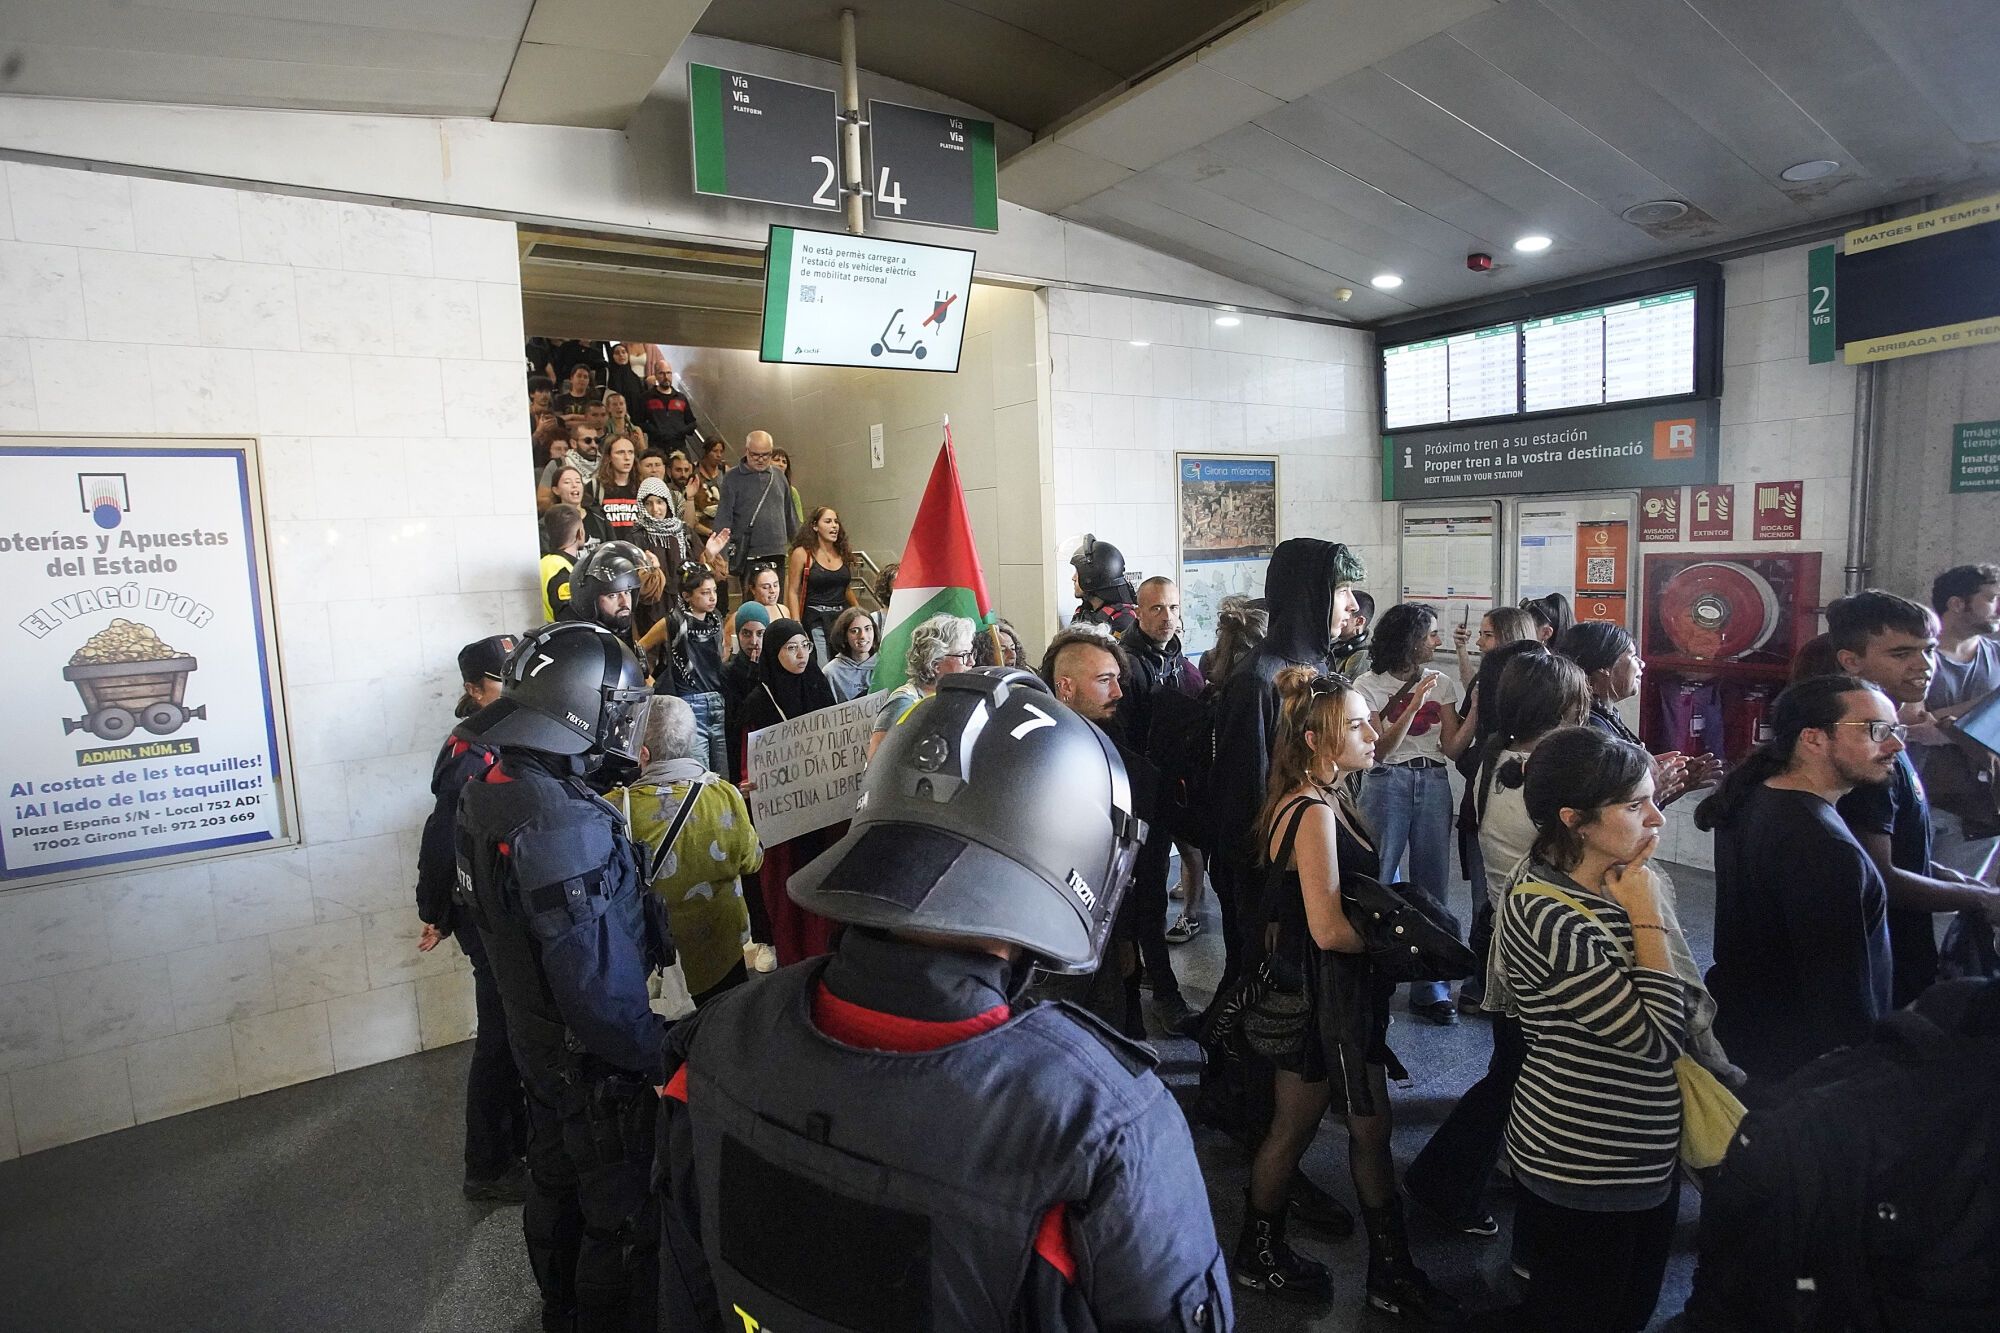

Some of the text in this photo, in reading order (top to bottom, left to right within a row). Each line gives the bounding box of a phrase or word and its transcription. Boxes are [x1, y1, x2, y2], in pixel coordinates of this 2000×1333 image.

[732, 76, 748, 88] Vía
[733, 90, 749, 104] Via
[733, 105, 762, 115] PLATFORM
[940, 143, 964, 151] PLATFORM
[950, 131, 963, 142] Via
[811, 156, 836, 206] 2
[878, 166, 907, 214] 4
[1853, 225, 1912, 246] IMATGES
[1917, 219, 1935, 230] EN
[1940, 206, 1990, 224] TEMPS
[803, 245, 813, 253] No
[816, 247, 833, 256] està
[836, 250, 865, 260] permès
[868, 253, 900, 264] carregar
[802, 256, 836, 268] l'estació
[852, 263, 883, 273] vehicles
[886, 266, 916, 277] elèctrics
[814, 270, 851, 280] mobilitat
[854, 275, 887, 284] personal
[1812, 286, 1830, 315] 2
[1812, 315, 1830, 326] Vía
[1867, 336, 1937, 354] ARRIBADA
[1942, 331, 1960, 342] DE
[1425, 430, 1588, 456] Próximo tren a su estación
[1670, 425, 1692, 448] R
[1962, 428, 2000, 438] Imáge
[1424, 441, 1643, 472] Proper tren a la vostra destinació
[1204, 466, 1228, 475] Girona
[1424, 470, 1523, 484] NEXT TRAIN TO YOUR STATION
[1961, 465, 1999, 474] temps
[0, 529, 229, 554] oterías y Apuestas
[47, 554, 177, 577] del Estado
[19, 582, 214, 639] EL VAGÓ D'OR
[530, 654, 554, 677] 7
[566, 712, 590, 730] T6X178
[1010, 703, 1057, 740] 7
[756, 730, 776, 750] PAZ
[782, 722, 808, 740] PARA
[82, 743, 192, 765] ADMIN. NÚM. 15
[754, 749, 778, 770] PARA
[781, 746, 793, 762] LA
[815, 734, 824, 750] Y
[828, 726, 862, 749] NUNCA
[10, 754, 262, 798] Al costat de les taquilles!
[770, 765, 800, 787] SOLO
[805, 755, 828, 776] DÍA
[832, 750, 848, 770] DE
[853, 746, 868, 765] PA
[16, 776, 262, 820] ¡Al lado de las taquillas!
[758, 790, 820, 820] PALESTINA
[12, 824, 59, 839] Plaza
[64, 816, 121, 833] España
[125, 810, 150, 823] S/N
[166, 803, 203, 817] Local
[207, 800, 231, 811] 752
[235, 795, 261, 807] ADI
[33, 812, 255, 851] 17002 Girona Tel: 972 203 669
